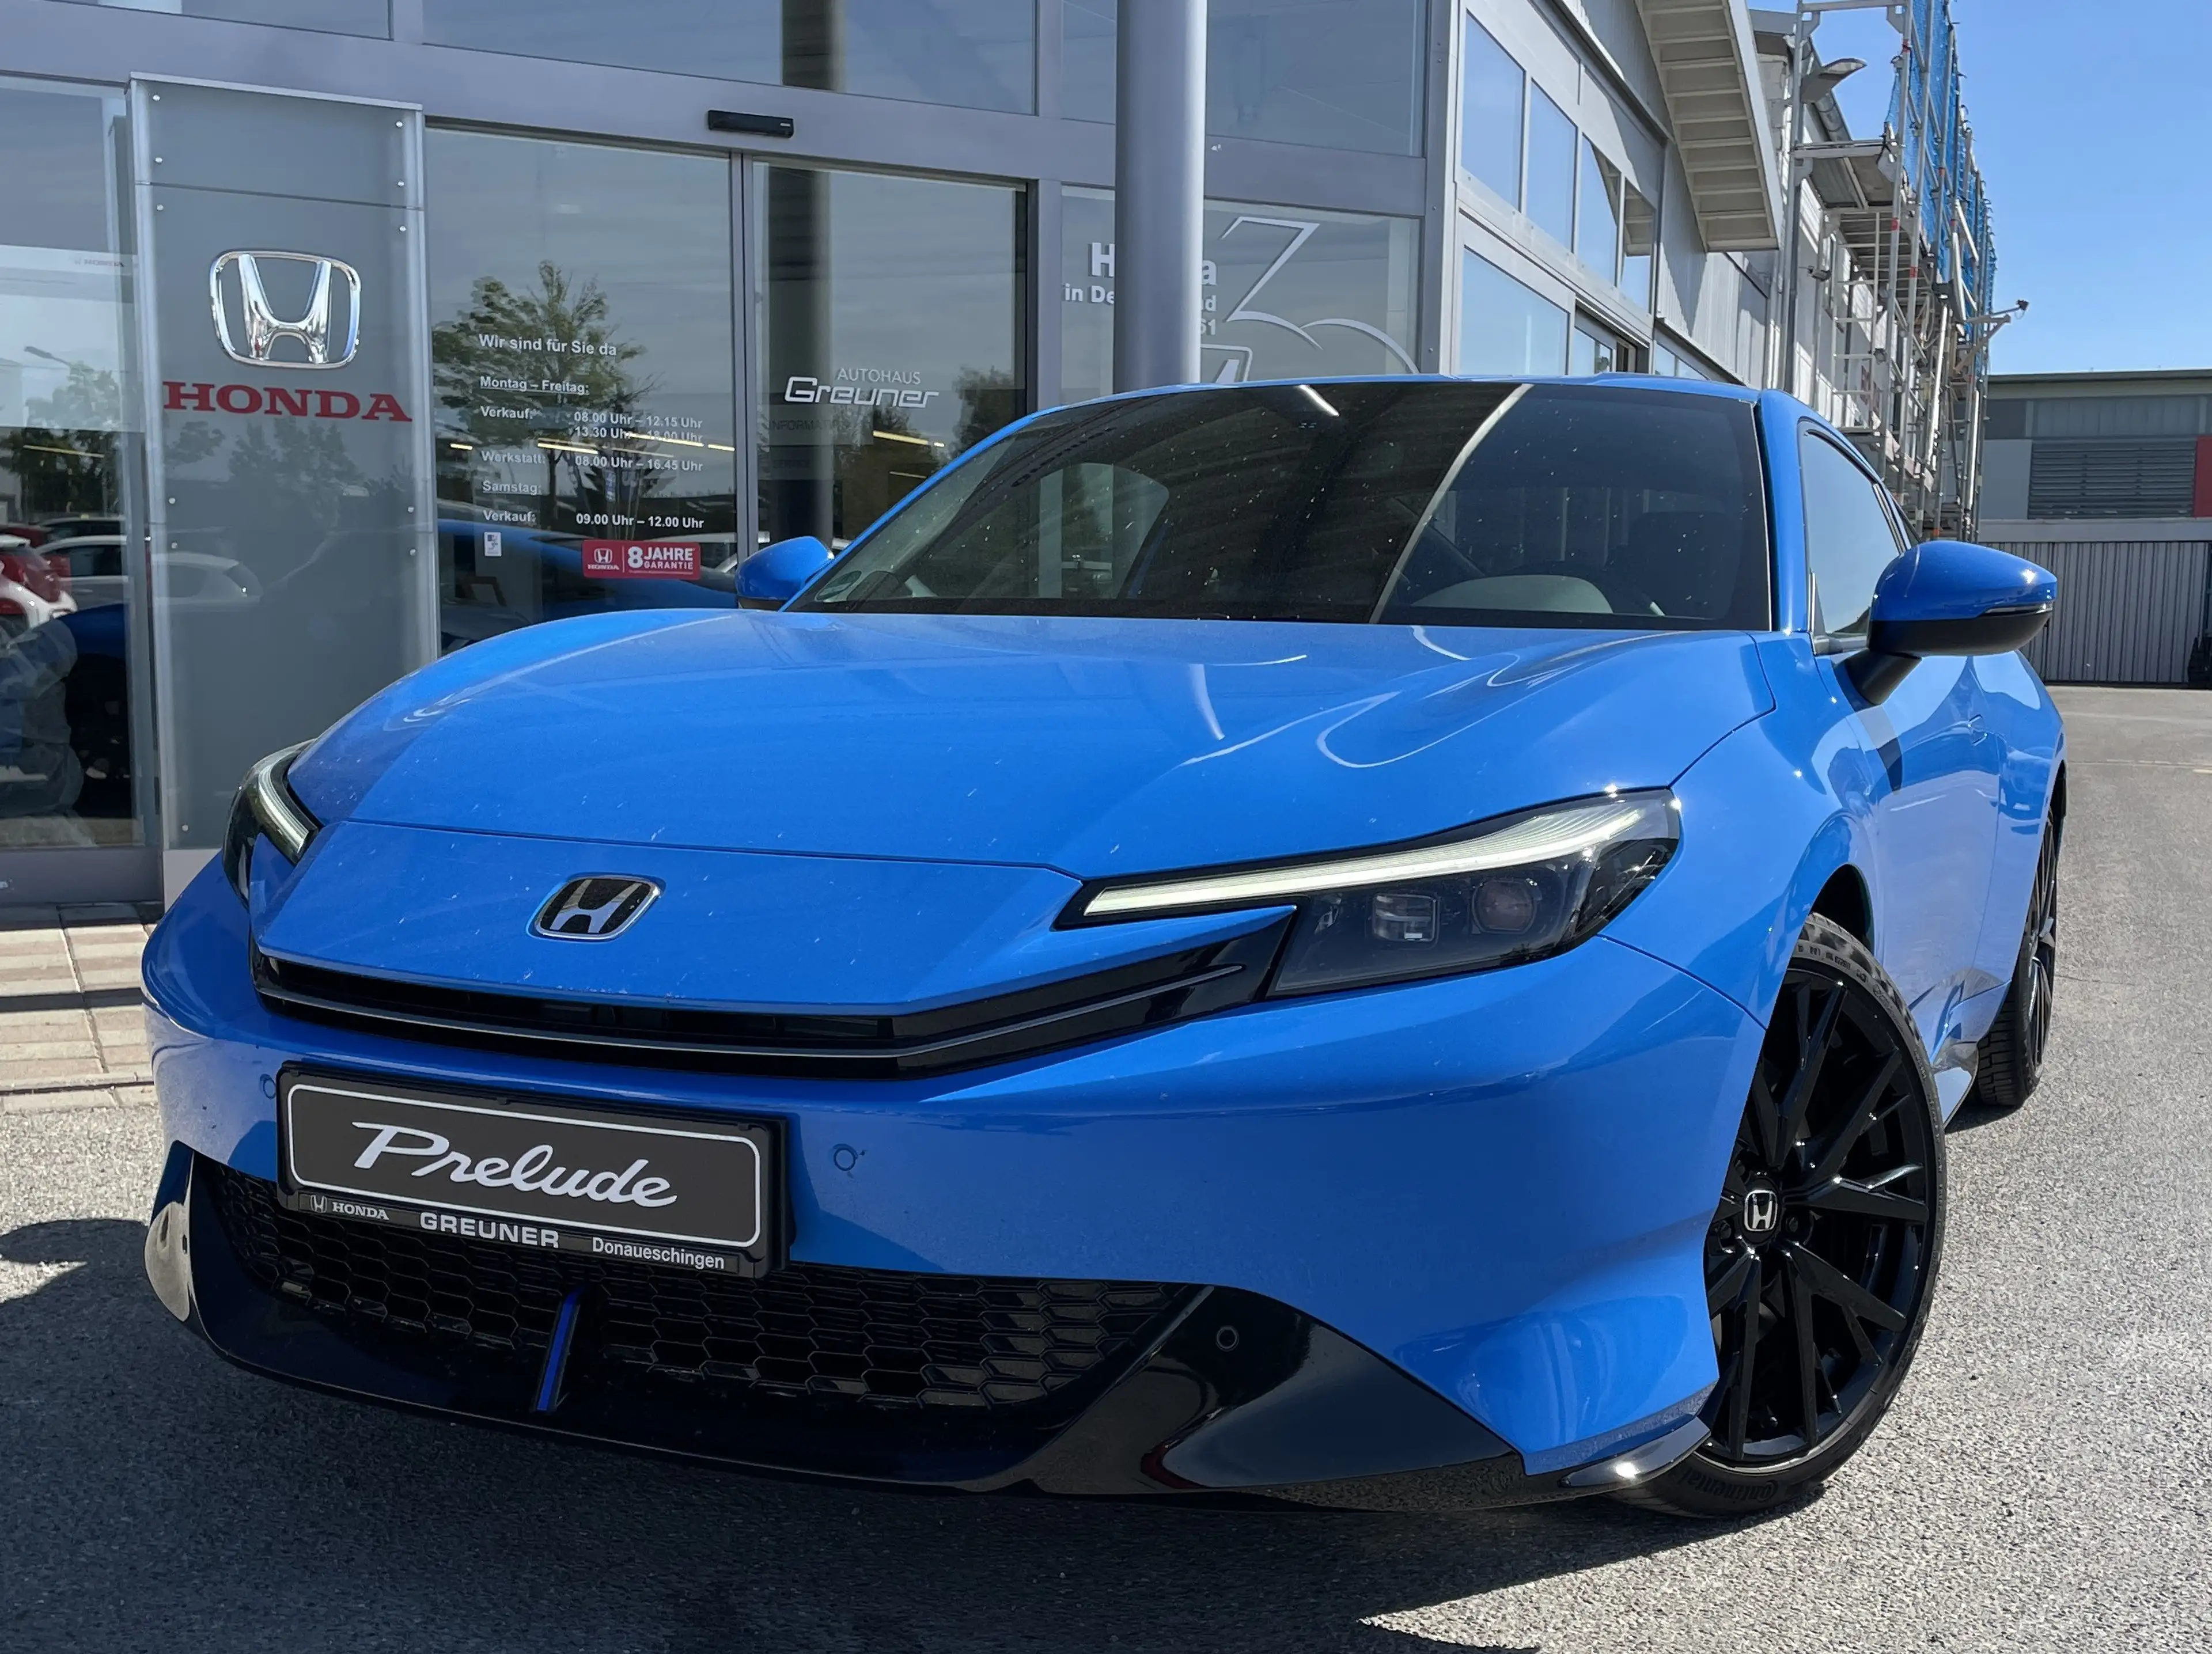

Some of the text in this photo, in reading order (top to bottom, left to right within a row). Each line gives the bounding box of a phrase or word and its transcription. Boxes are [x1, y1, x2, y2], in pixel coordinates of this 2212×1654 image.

[1064, 283, 1084, 302] in
[479, 333, 617, 356] Wir sind für Sie da
[480, 375, 527, 391] Montag
[837, 367, 921, 385] AUTOHAUS
[785, 375, 940, 408] Greuner
[162, 381, 413, 422] HONDA
[574, 411, 607, 423] 08.00
[610, 413, 632, 425] Uhr
[646, 416, 677, 427] 12.15
[681, 416, 703, 429] Uhr
[574, 426, 607, 438] 13.30
[575, 456, 607, 467] 08.00
[611, 457, 633, 468] Uhr
[647, 459, 678, 471] 16.45
[681, 460, 703, 472] Uhr
[575, 513, 608, 525] 09.00
[612, 514, 634, 526] Uhr
[648, 516, 679, 528] 12.00
[682, 517, 704, 529] Uhr
[627, 546, 694, 569] 8 JAHRE
[643, 560, 694, 570] GARANTIE
[351, 1120, 679, 1209] Prelude
[332, 1201, 725, 1270] HONDA GREUNER Donaueschingen
